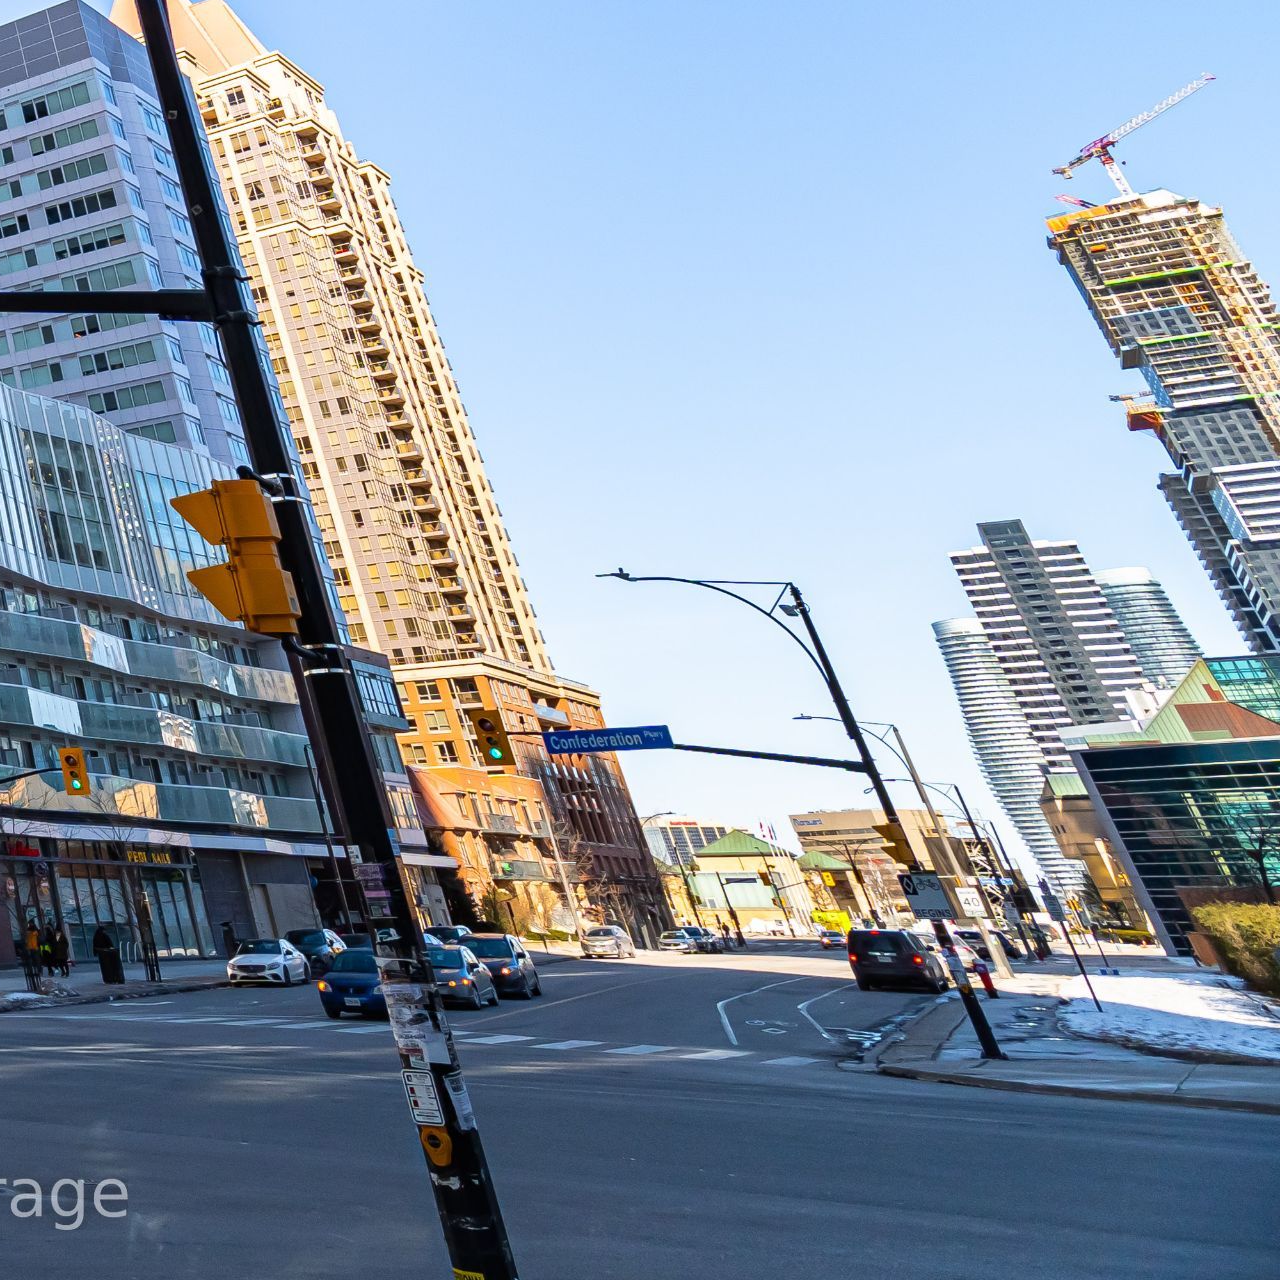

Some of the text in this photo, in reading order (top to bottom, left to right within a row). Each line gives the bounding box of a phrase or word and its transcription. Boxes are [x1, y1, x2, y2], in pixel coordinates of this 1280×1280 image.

[550, 733, 642, 750] Confederation
[963, 898, 980, 907] 40
[915, 908, 953, 918] BEGINS
